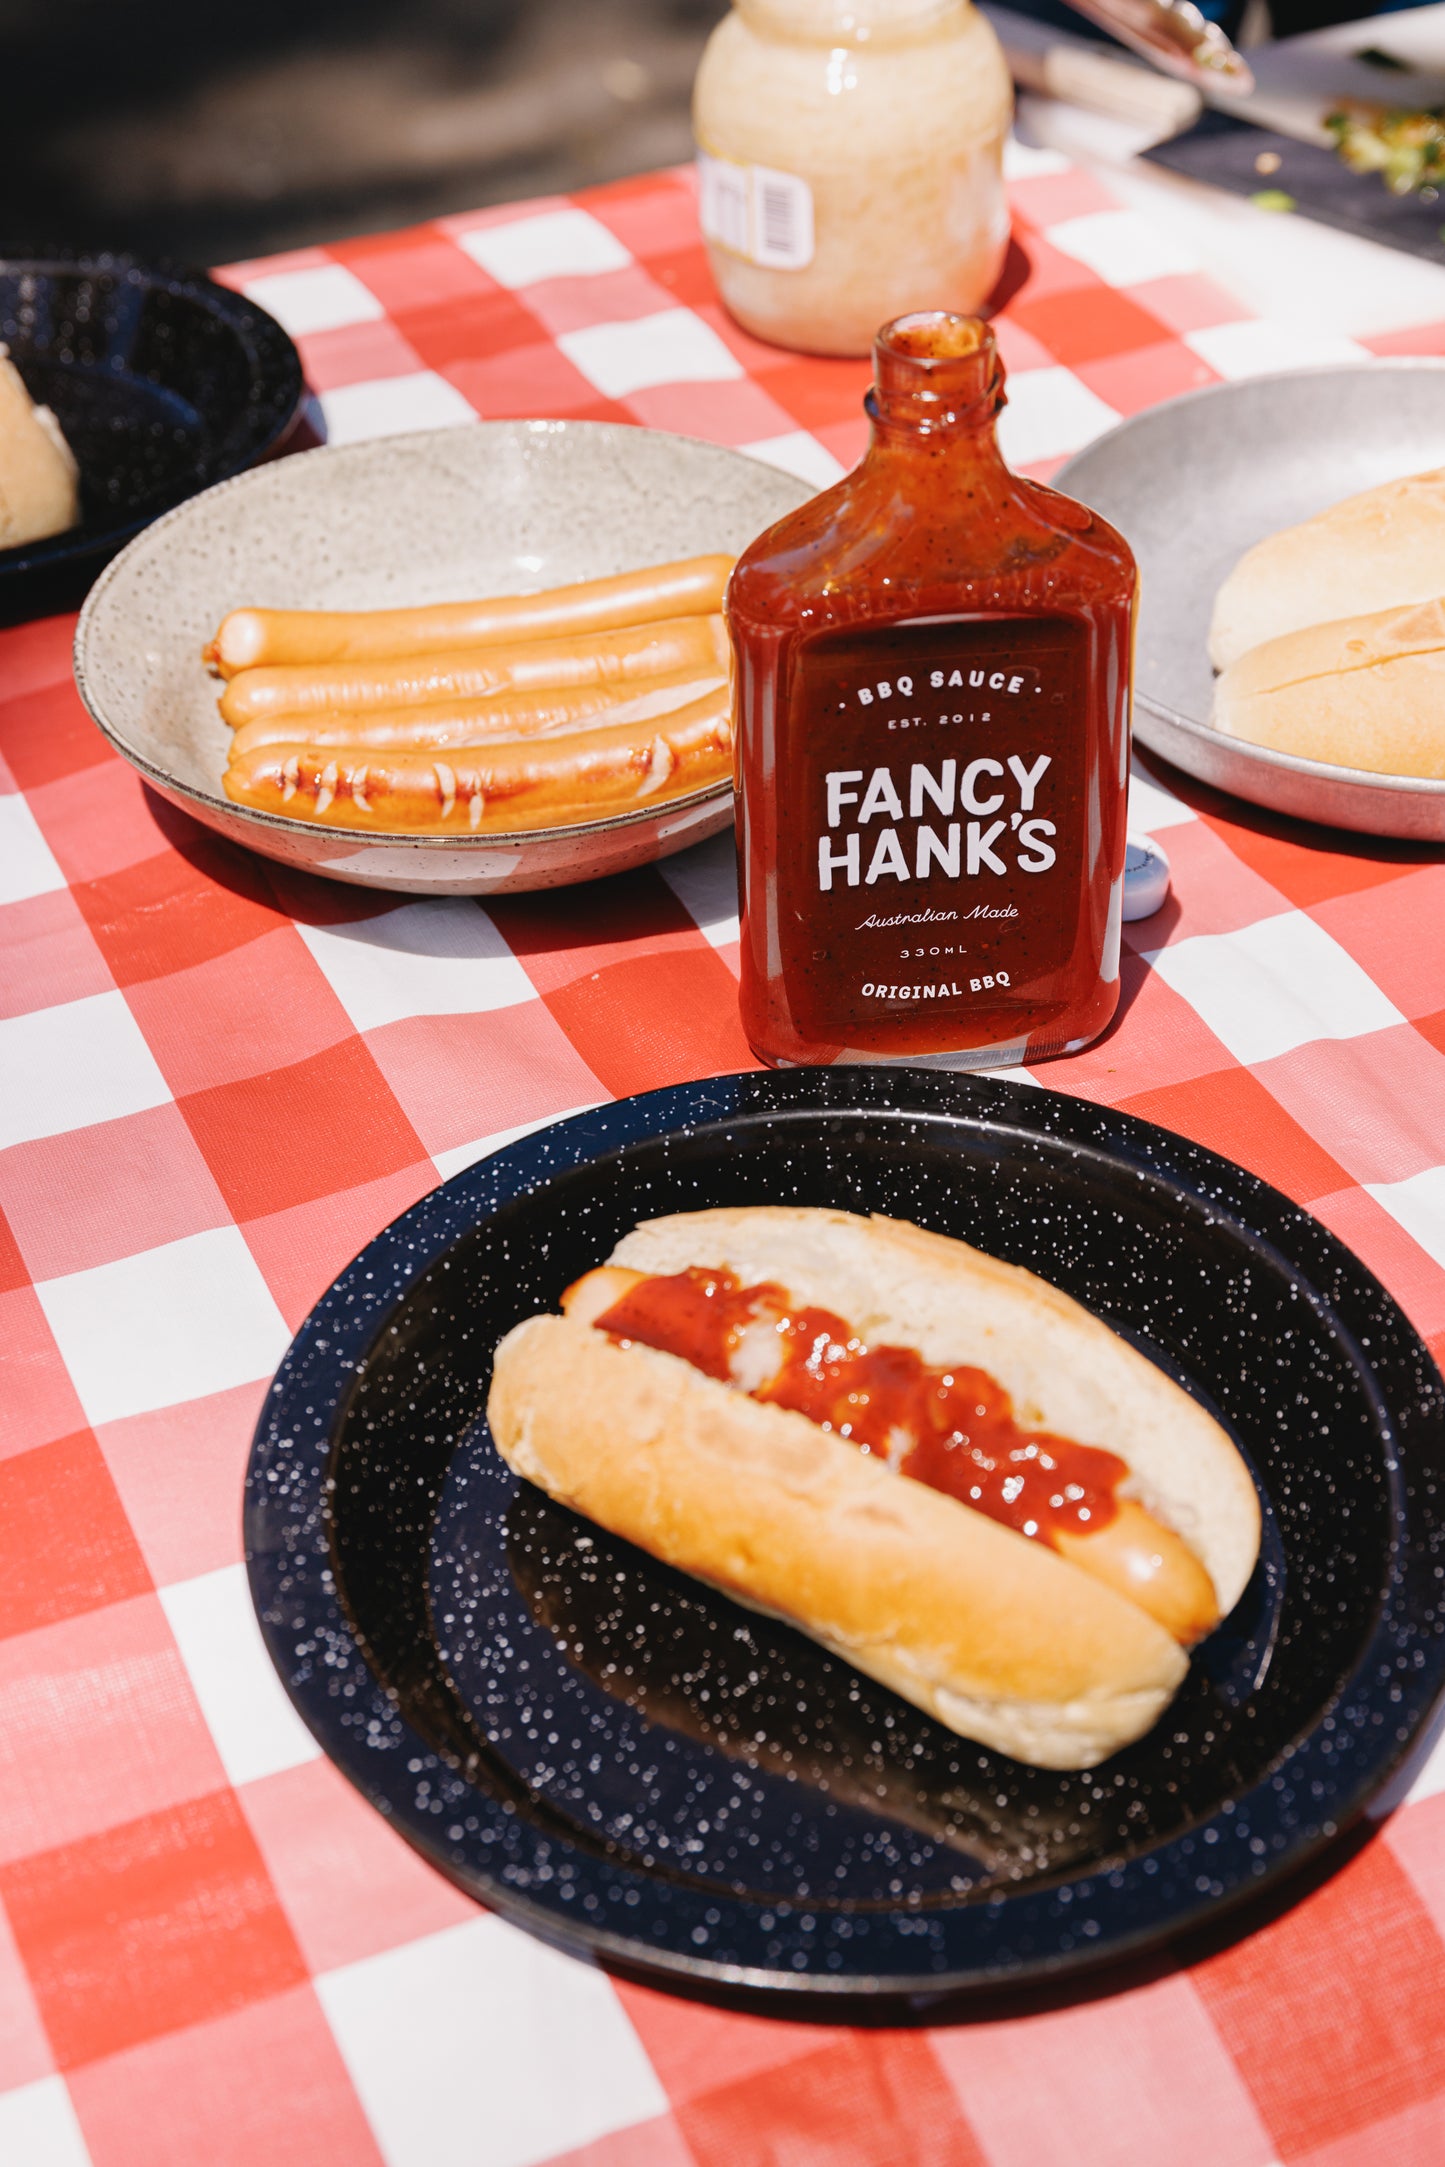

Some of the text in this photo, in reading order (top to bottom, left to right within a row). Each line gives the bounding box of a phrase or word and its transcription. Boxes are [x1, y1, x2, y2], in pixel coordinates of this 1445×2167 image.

[857, 669, 1025, 705] BBQ SAUCE
[887, 712, 992, 730] EST. 2012
[825, 754, 1052, 828] FANCY
[818, 812, 1057, 891] HANK'S
[854, 904, 1019, 931] Australian Made
[899, 945, 968, 959] 330ML
[861, 971, 1012, 1000] ORIGINAL BBQ
